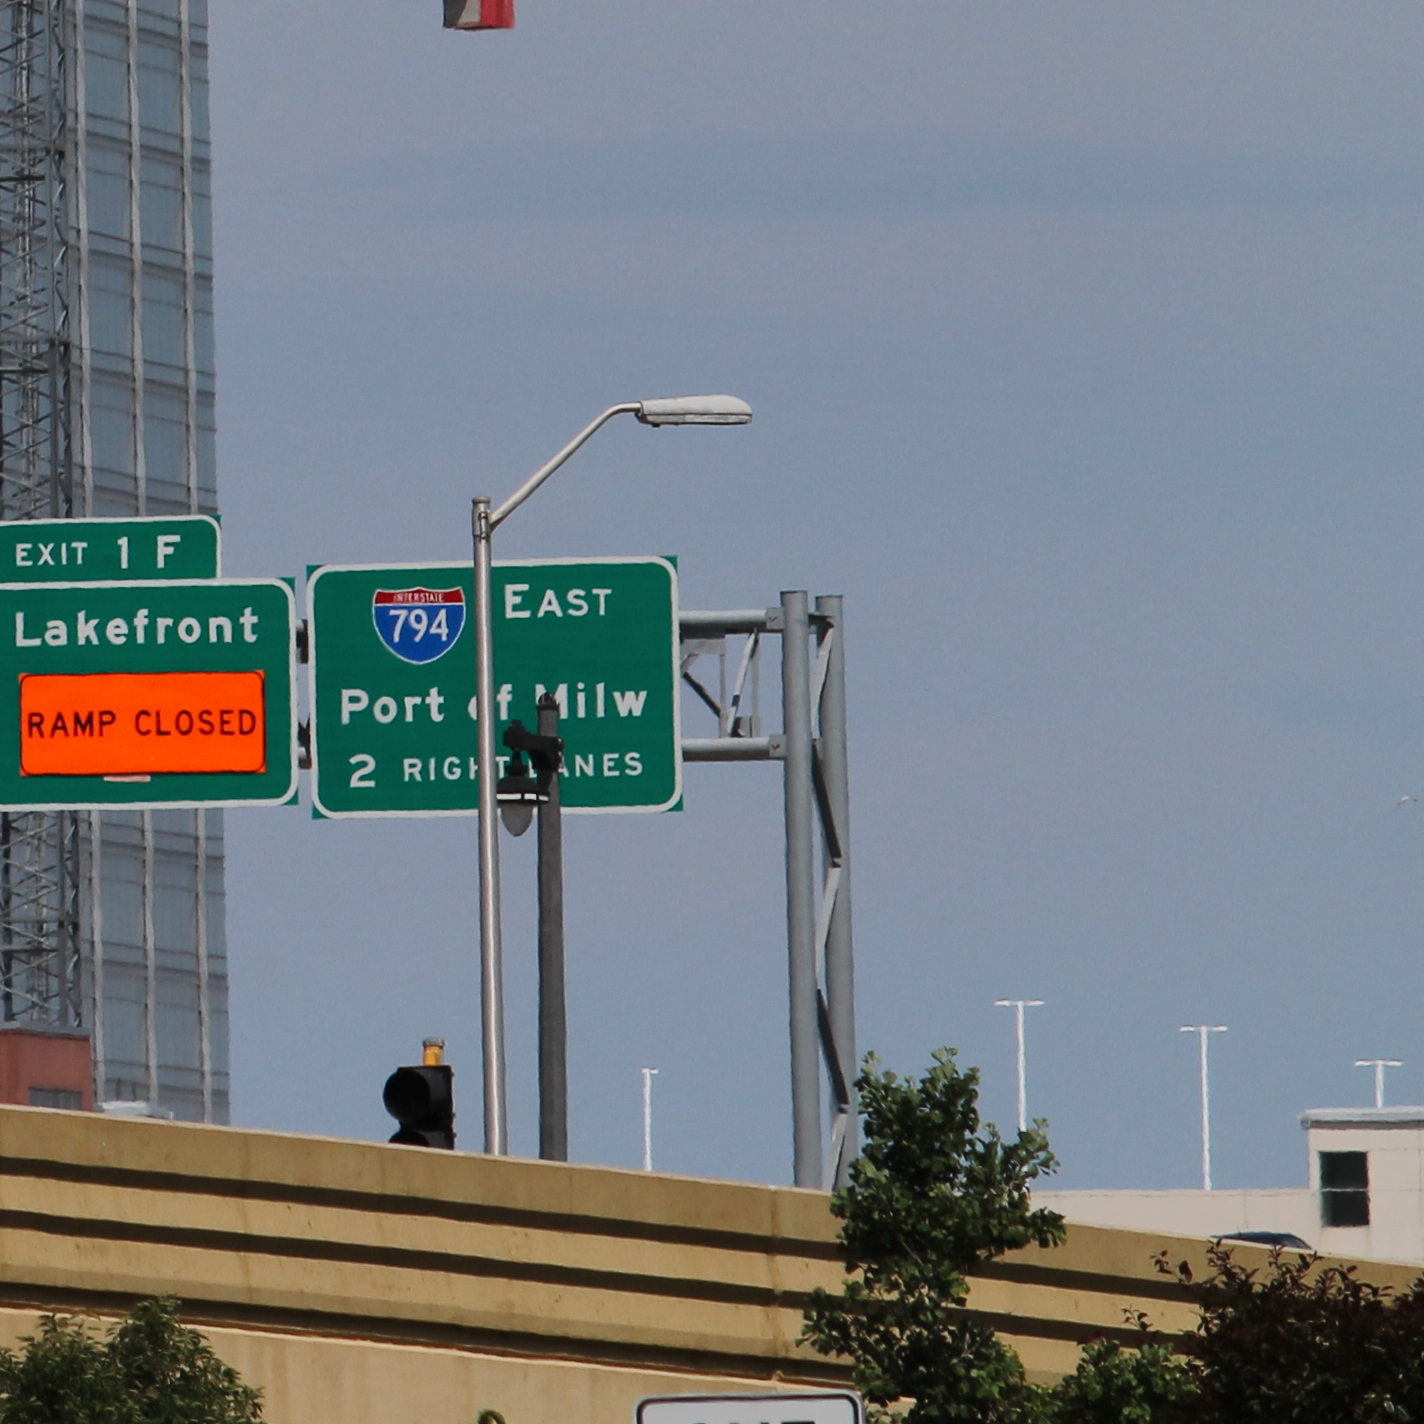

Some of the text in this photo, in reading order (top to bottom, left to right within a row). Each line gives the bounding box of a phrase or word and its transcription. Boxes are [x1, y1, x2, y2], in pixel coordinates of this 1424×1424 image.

[15, 542, 88, 566] EXIT
[393, 592, 444, 603] INTERSTATE
[504, 584, 612, 619] EAST
[15, 607, 259, 647] Lakefront
[388, 608, 449, 643] 794
[341, 687, 445, 725] Port
[27, 709, 257, 739] RAMP CLOSED
[349, 754, 377, 789] 2
